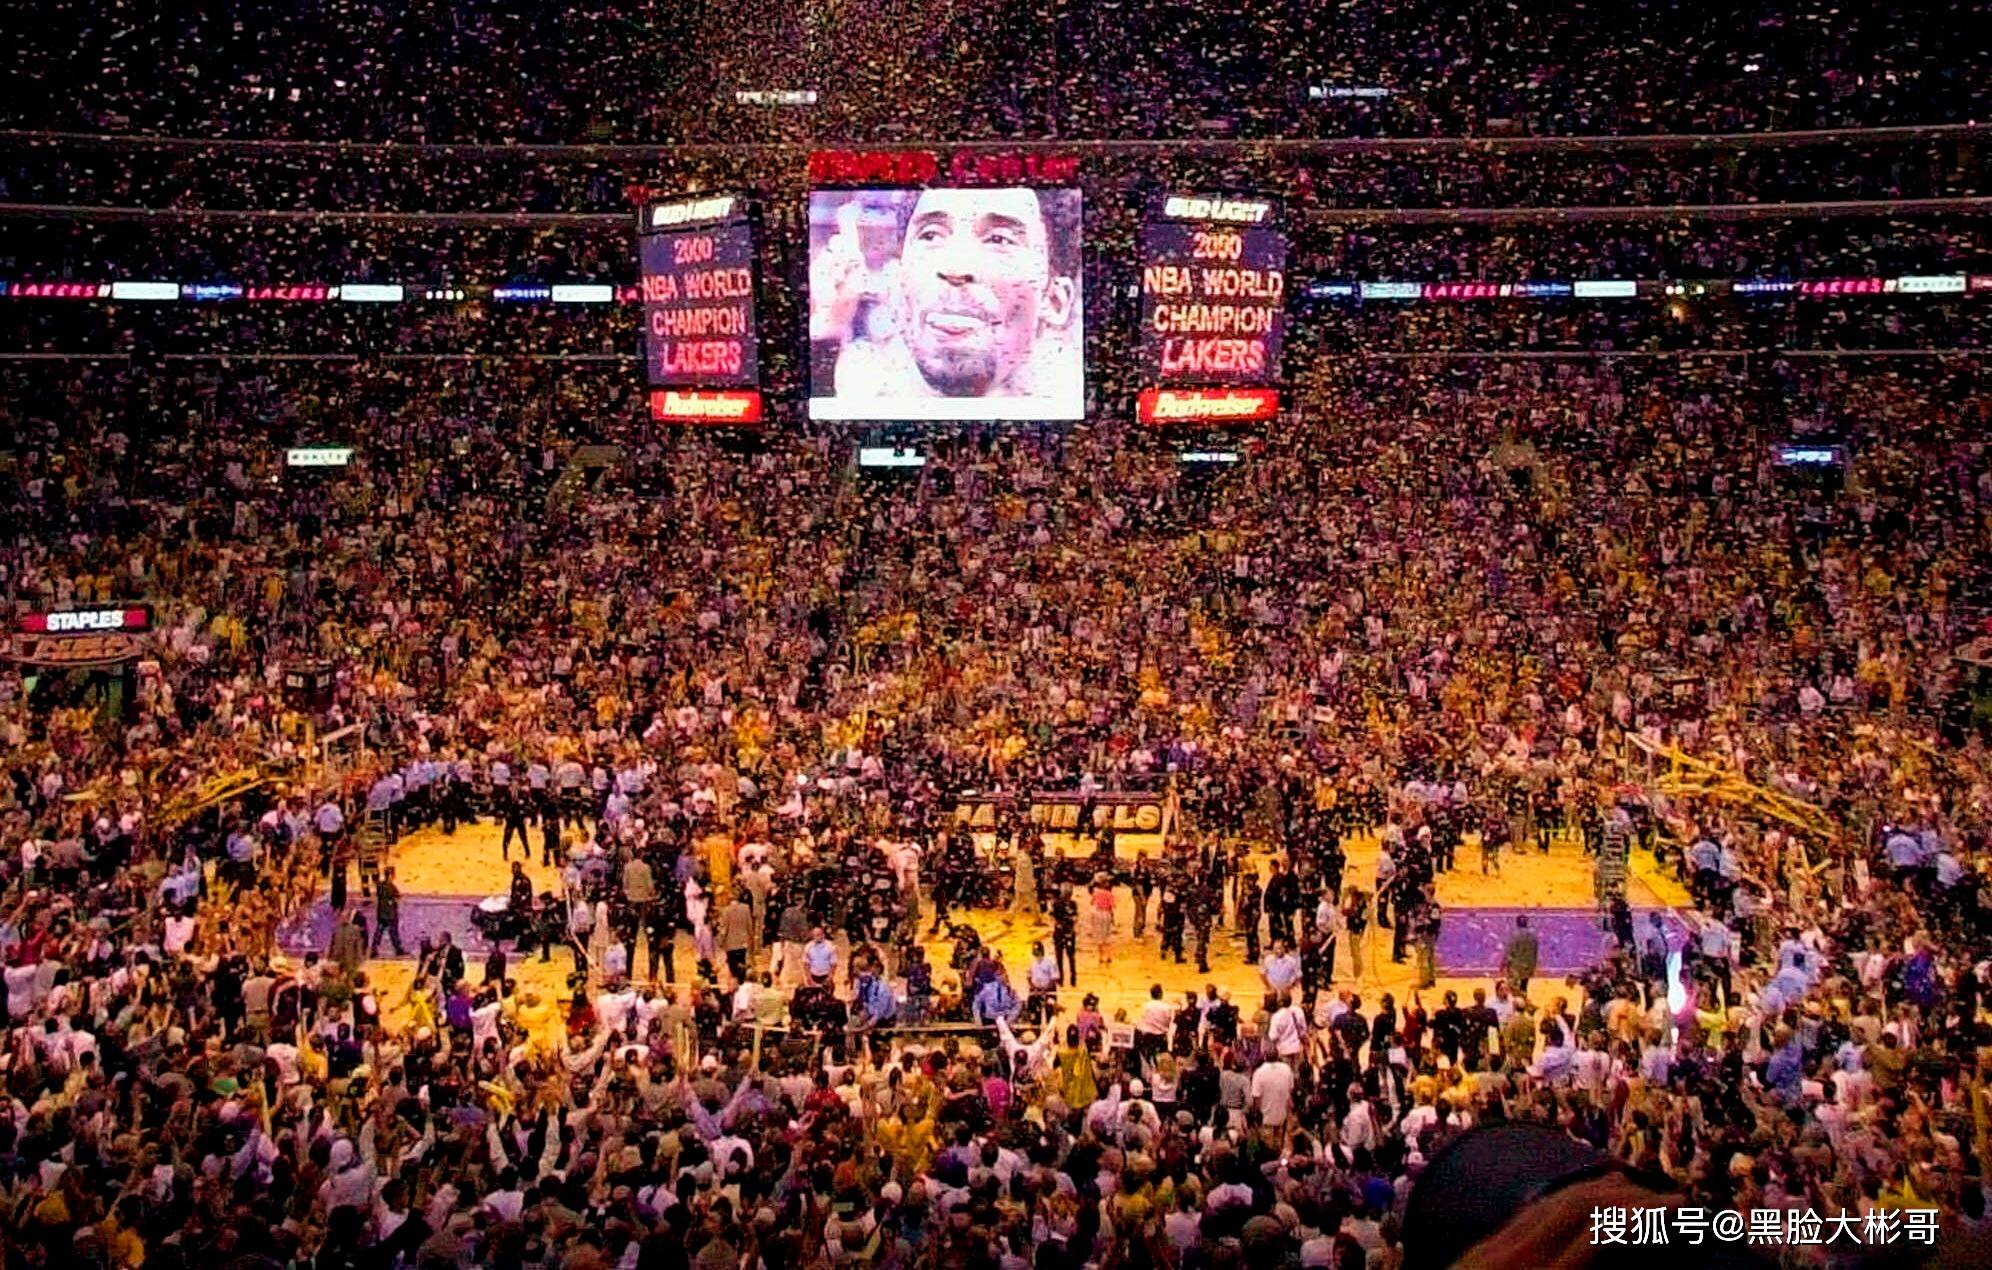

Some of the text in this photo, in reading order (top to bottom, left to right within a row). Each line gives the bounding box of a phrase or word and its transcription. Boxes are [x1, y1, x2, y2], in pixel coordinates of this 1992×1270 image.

[1165, 197, 1269, 222] BUD LIGHT
[674, 235, 713, 264] 2000
[1193, 231, 1241, 260] 2000
[12, 283, 95, 297] LAKERS
[643, 274, 679, 301] NBA
[684, 267, 751, 299] WORLD
[1144, 266, 1284, 297] NBA WORLD
[1424, 284, 1498, 297] LAKERS
[1801, 278, 1881, 294] LAKERS
[652, 306, 746, 336] CHAMPION
[1153, 304, 1273, 333] CHAMPION
[663, 341, 742, 373] LAKERS
[1161, 339, 1265, 371] LAKERS
[662, 391, 750, 417] Budweiser
[1151, 391, 1264, 418] Budweiser
[46, 610, 125, 631] STAPLES
